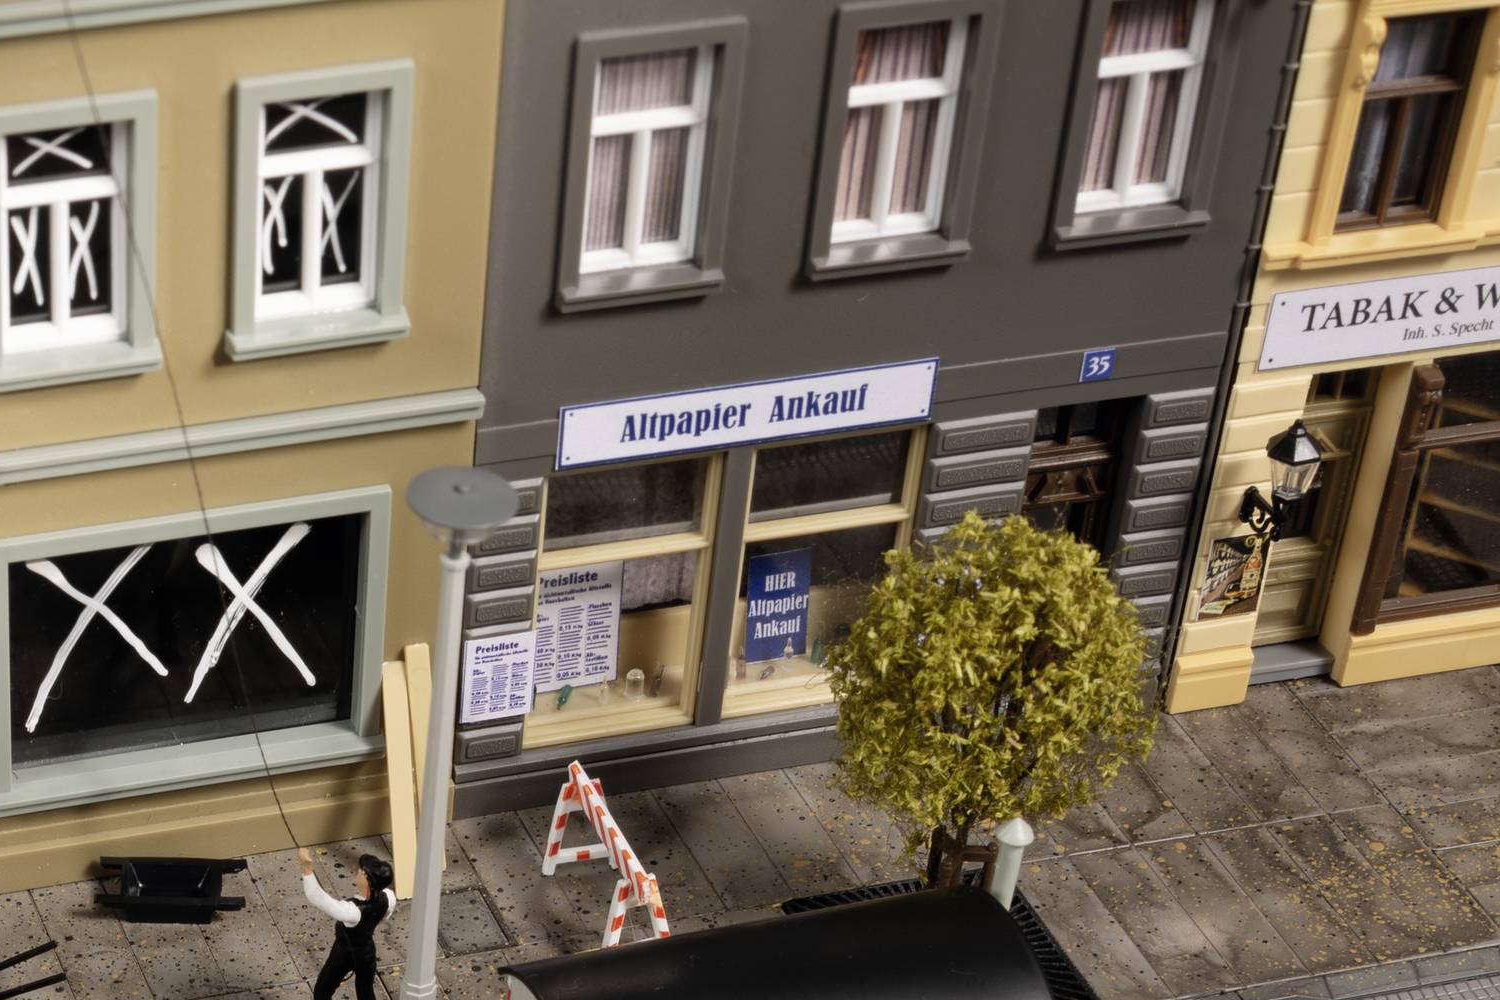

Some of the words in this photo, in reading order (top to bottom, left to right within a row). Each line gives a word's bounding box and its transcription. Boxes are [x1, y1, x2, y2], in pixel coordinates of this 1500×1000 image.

[1301, 290, 1428, 332] TABAK
[1434, 286, 1464, 315] &
[1403, 328, 1428, 341] Inh.
[1432, 324, 1445, 337] S.
[1449, 318, 1494, 337] Specht
[1086, 355, 1111, 377] 35
[620, 402, 751, 442] Altpapier
[768, 384, 868, 423] Ankauf
[765, 571, 796, 592] HIER
[748, 593, 809, 617] Altpapier
[754, 615, 801, 639] Ankauf
[475, 642, 519, 654] Preisliste
